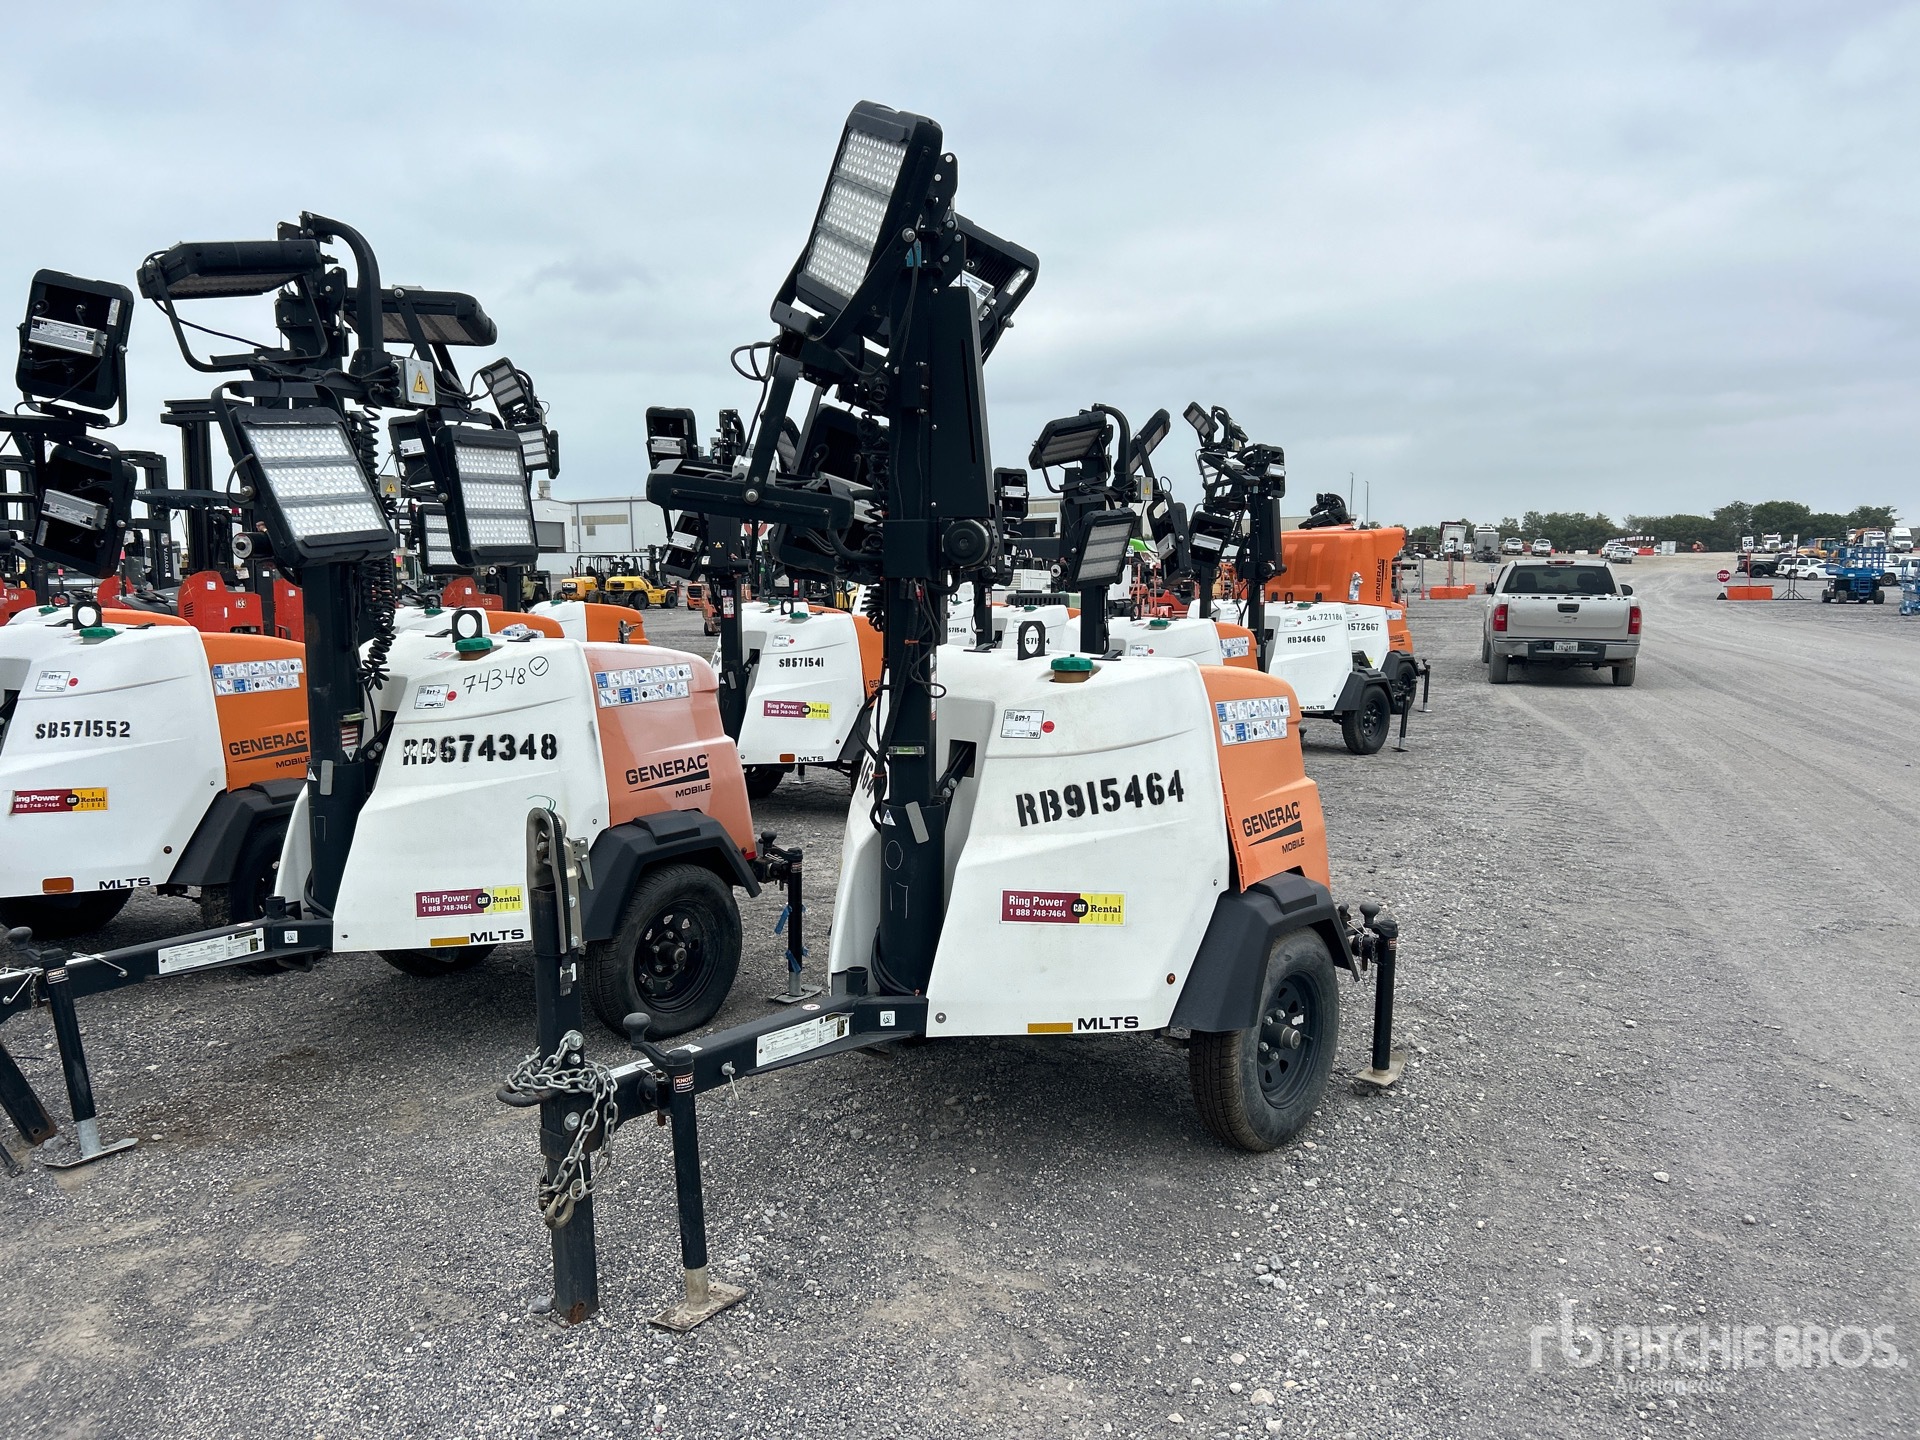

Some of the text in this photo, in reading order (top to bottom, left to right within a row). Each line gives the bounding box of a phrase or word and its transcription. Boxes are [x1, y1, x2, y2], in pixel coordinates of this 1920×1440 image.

[1376, 558, 1384, 602] GENERAC
[463, 667, 526, 694] 74348
[35, 720, 130, 740] SB571552
[229, 730, 307, 756] GENERAC
[402, 734, 558, 766] RB674348
[276, 756, 310, 768] MOBILE
[625, 754, 709, 786] GENERAC
[675, 782, 712, 798] MOBILE
[15, 794, 30, 804] ing
[1015, 769, 1185, 828] RB915464
[1242, 801, 1301, 838] GENERAC
[1282, 836, 1306, 854] MOBILE
[98, 876, 150, 890] MLTS
[422, 894, 470, 905] Ring Power
[477, 895, 521, 904] CAT Rental
[1008, 895, 1064, 908] Ring Power
[442, 904, 472, 912] 748-7464
[1016, 908, 1030, 916] 888
[1032, 909, 1066, 918] 748-7464
[1073, 904, 1122, 914] CAT Rental
[470, 928, 524, 943] MLTS
[1077, 1016, 1140, 1030] MLTS
